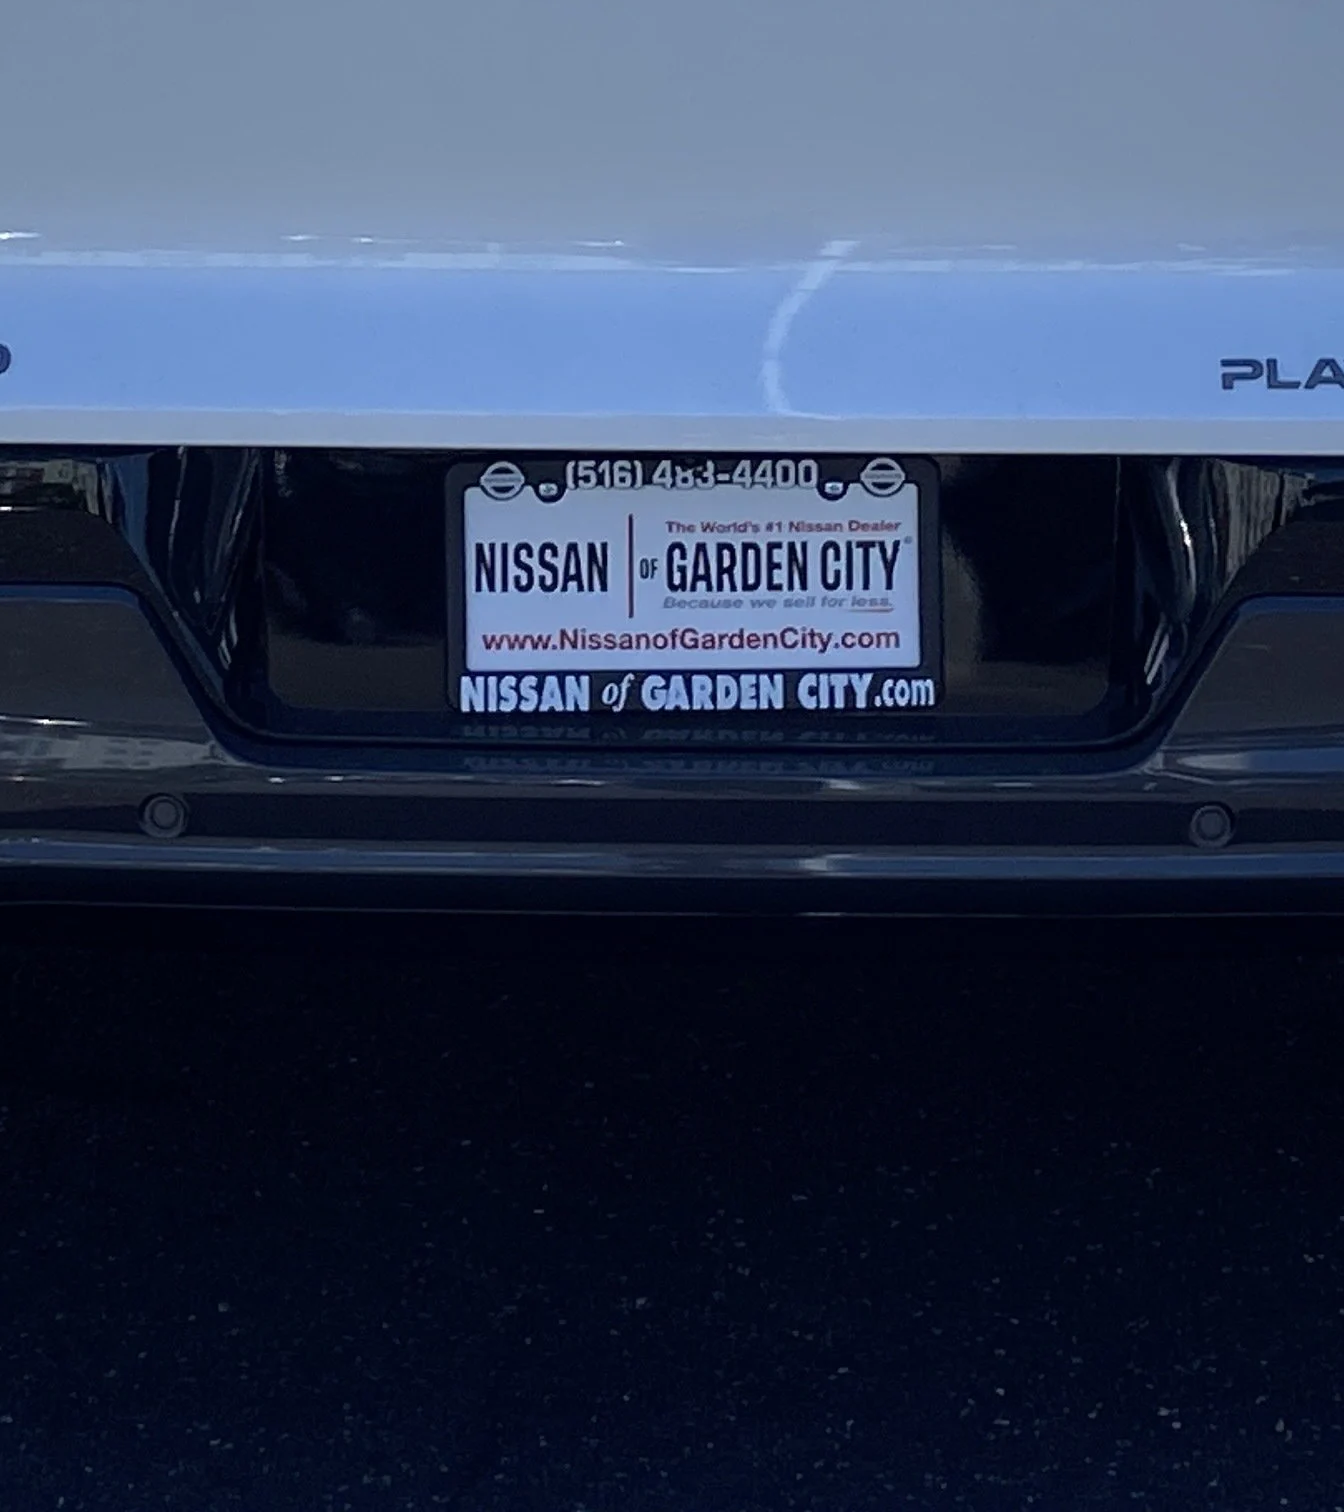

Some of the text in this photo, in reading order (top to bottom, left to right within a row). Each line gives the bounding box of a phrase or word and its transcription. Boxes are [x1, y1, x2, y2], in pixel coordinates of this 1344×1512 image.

[565, 459, 820, 489] (516) 483-4400
[665, 519, 902, 534] The World's #1 Nissan Dealer
[474, 540, 901, 593] NISSAN OF GARDEN CITY
[662, 597, 744, 609] Because
[749, 598, 777, 609] we
[782, 596, 816, 609] sell
[820, 596, 846, 608] for
[481, 627, 901, 654] www.NissanofGardenCity.com
[459, 672, 936, 713] NISSAN of GARDEN CITY.com
